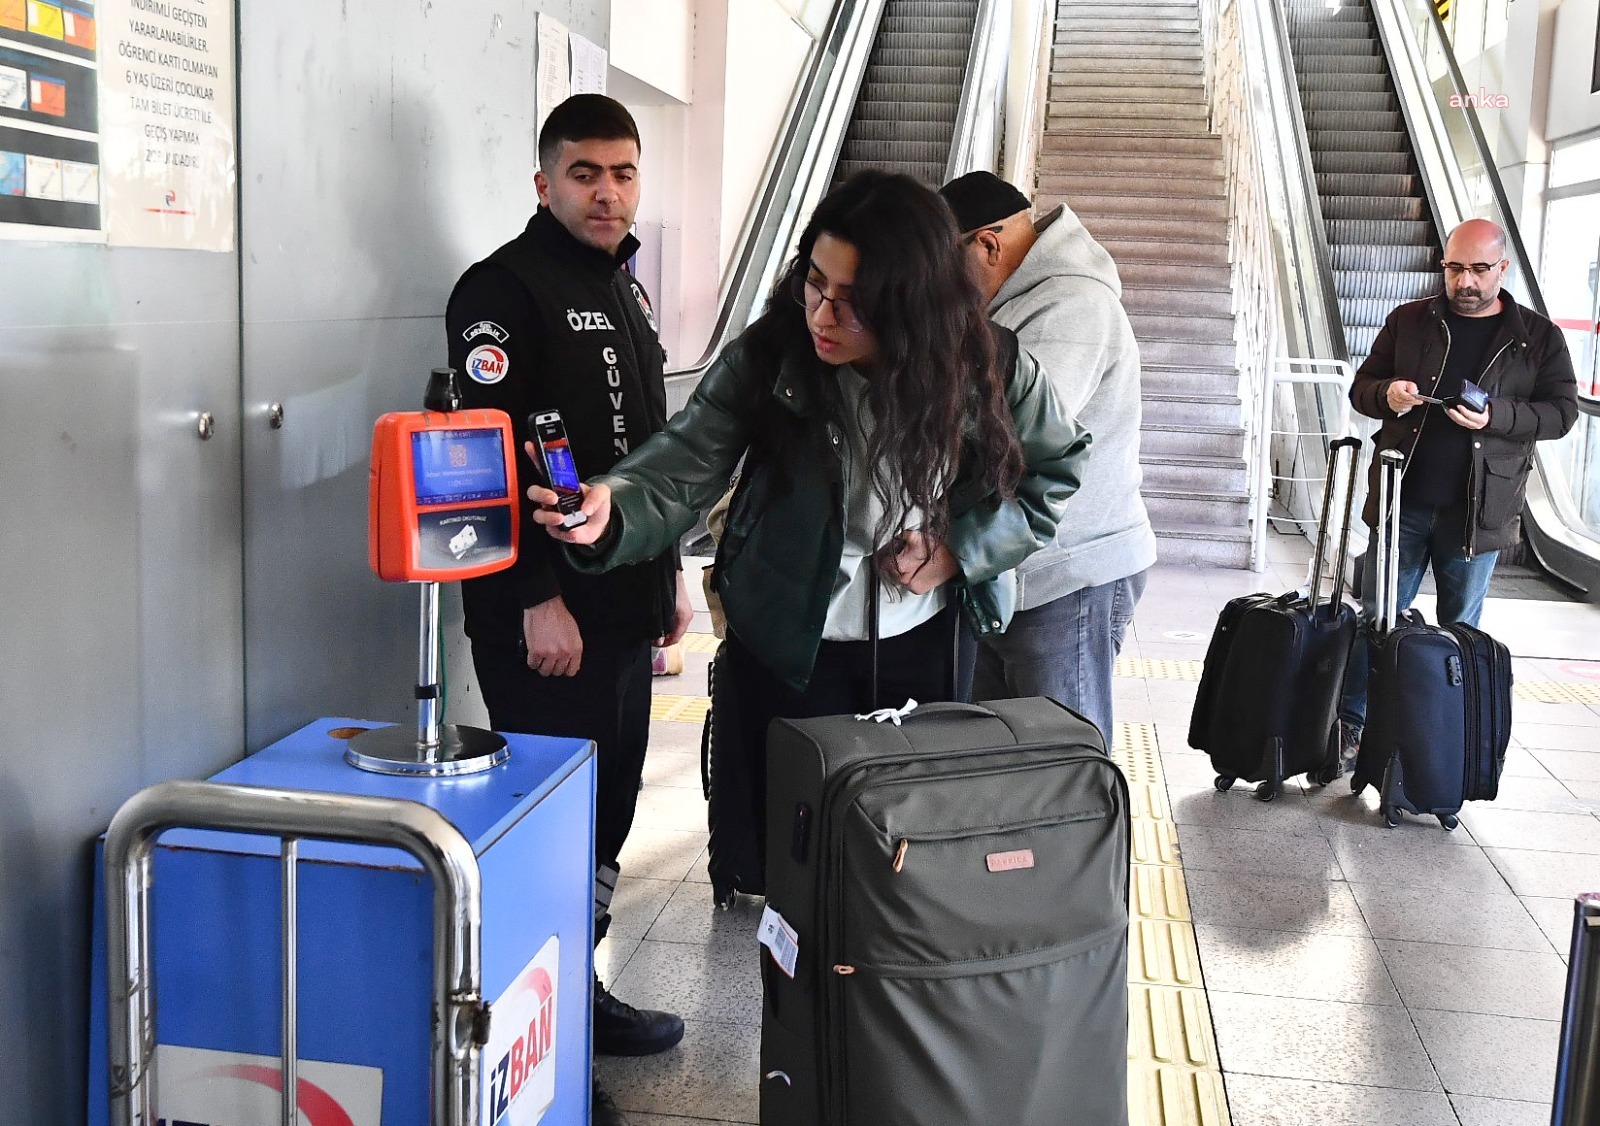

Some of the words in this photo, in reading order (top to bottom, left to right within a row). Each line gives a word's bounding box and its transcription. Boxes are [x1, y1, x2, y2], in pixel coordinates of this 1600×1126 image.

[172, 7, 207, 28] GEÇİŞTEN
[118, 41, 156, 63] ÖĞRENCİ
[158, 52, 180, 69] KARTI
[182, 59, 218, 78] OLMAYAN
[126, 70, 132, 83] 6
[133, 71, 149, 87] YAŞ
[151, 73, 173, 92] ÜZERİ
[175, 81, 214, 100] ÇOCUKLAR
[130, 96, 149, 112] TAM
[152, 99, 171, 117] BİLET
[145, 124, 167, 143] GEÇİŞ
[169, 128, 200, 145] YAPMAK
[567, 308, 616, 332] ÖZEL
